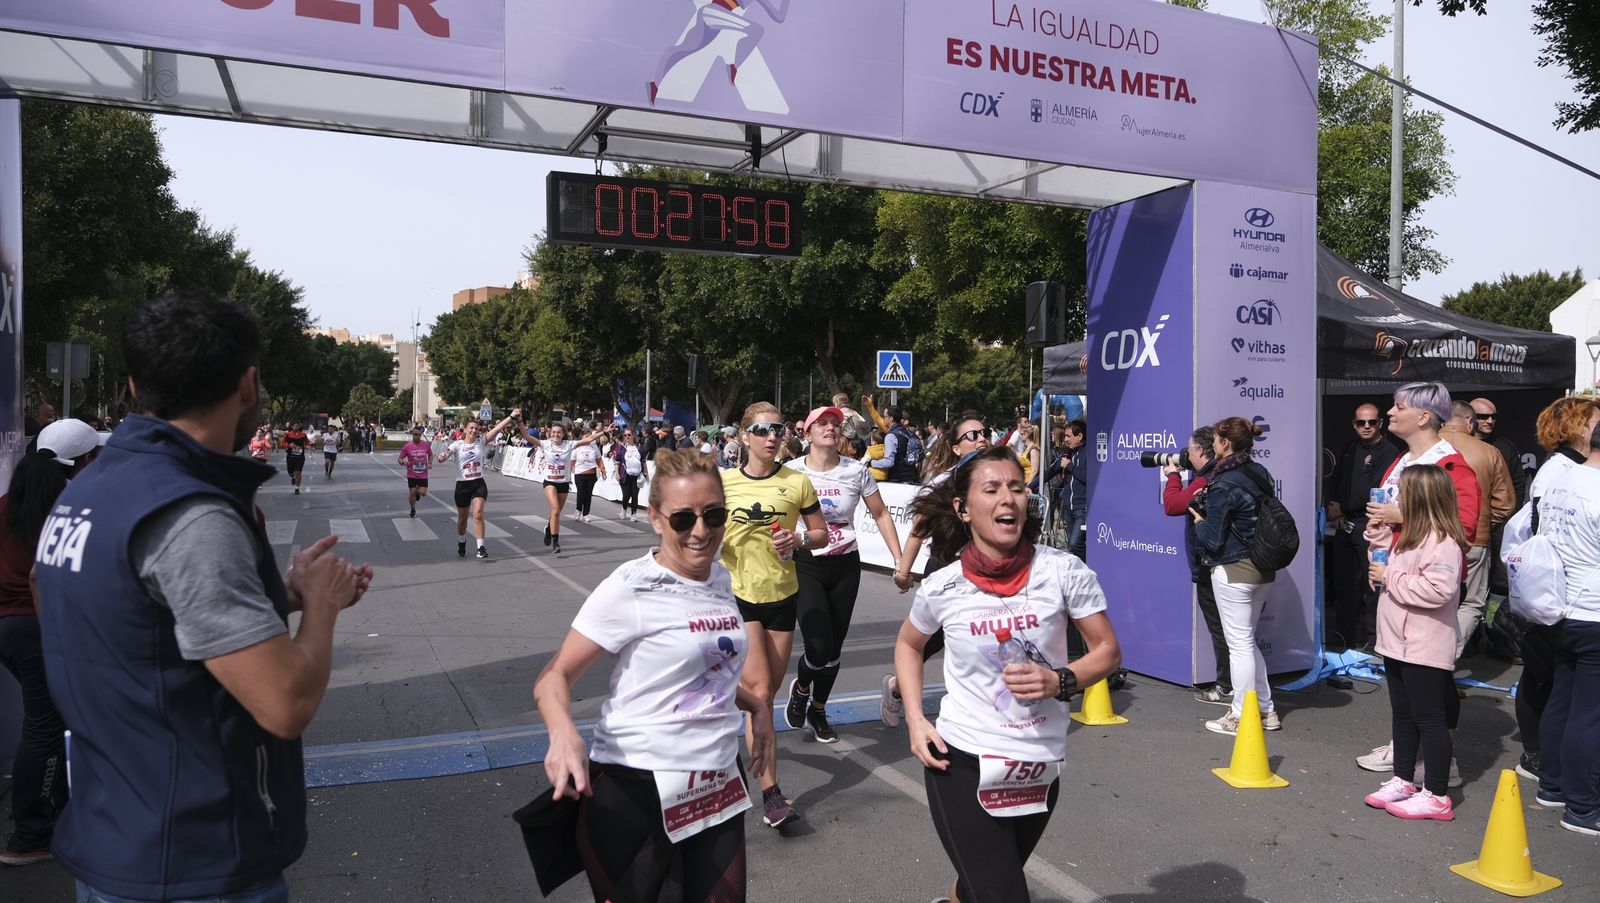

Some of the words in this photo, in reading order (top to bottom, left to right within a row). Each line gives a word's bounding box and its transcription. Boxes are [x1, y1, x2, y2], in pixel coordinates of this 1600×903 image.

[991, 0, 1024, 31] LA
[1033, 7, 1159, 55] IGUALDAD
[947, 37, 982, 68] ES
[990, 45, 1115, 92] NUESTRA
[1121, 69, 1197, 104] META.
[960, 92, 1004, 118] CDX
[1052, 102, 1098, 121] ALMERÍA
[1052, 115, 1076, 127] CIUDAD
[595, 184, 790, 248] 00:27:58
[1233, 228, 1285, 243] HYUNDAI
[1240, 241, 1280, 253] Almerialva
[1247, 266, 1288, 280] cajamar
[1236, 304, 1273, 326] CASI
[1101, 314, 1170, 371] CDX
[1248, 340, 1286, 354] vithas
[1446, 360, 1490, 371] cronometraje
[1491, 363, 1523, 374] deportivo
[1239, 384, 1284, 401] aqualia
[1117, 430, 1177, 448] ALMERÍA
[1250, 449, 1271, 458] ece
[688, 616, 740, 633] MUJER
[970, 614, 1040, 636] MUJER
[1003, 761, 1047, 780] 750
